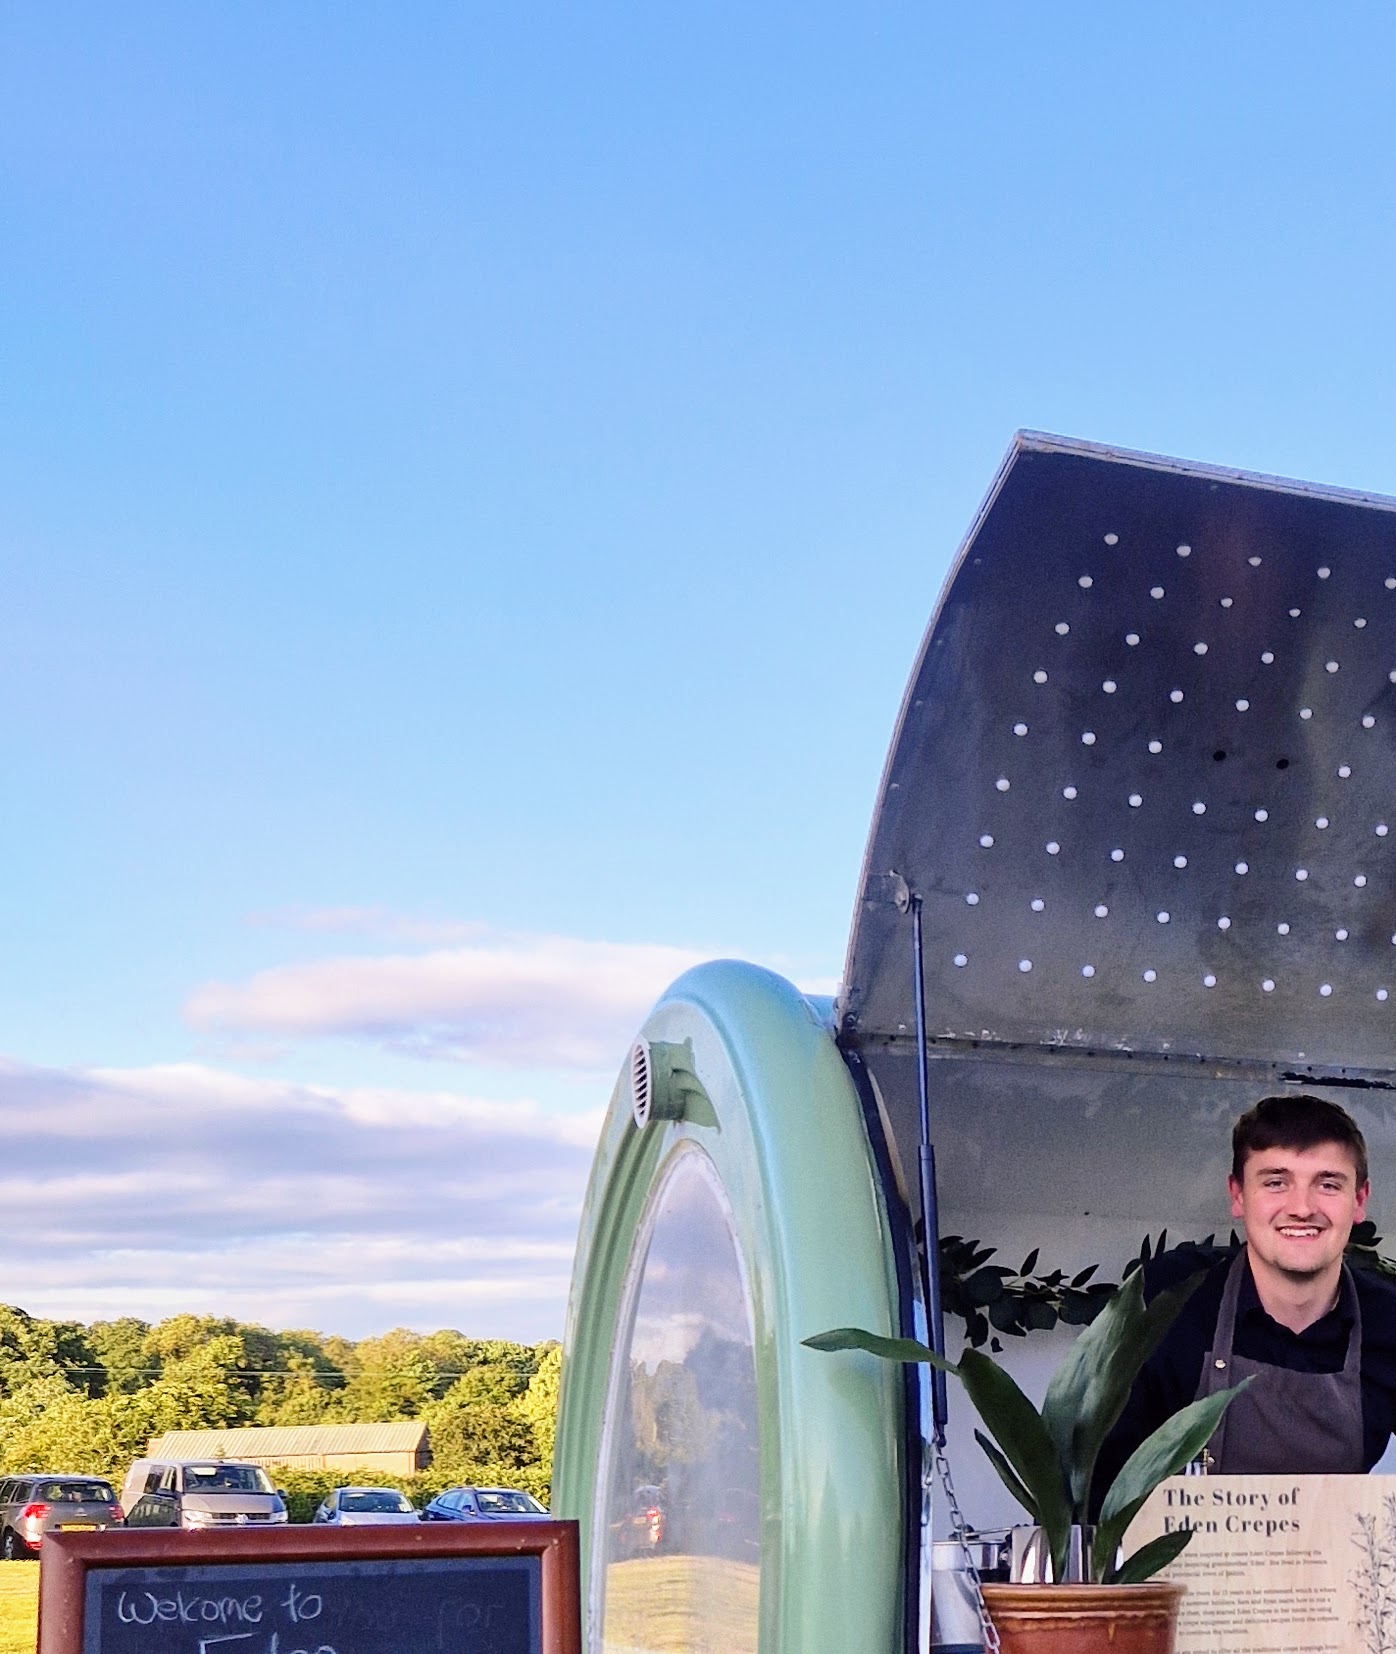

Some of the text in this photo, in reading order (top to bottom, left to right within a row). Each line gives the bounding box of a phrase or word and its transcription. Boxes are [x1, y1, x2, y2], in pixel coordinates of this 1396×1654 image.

[1163, 1487, 1300, 1511] The Story of
[1164, 1515, 1300, 1537] Eden Crepes
[282, 1584, 323, 1621] to
